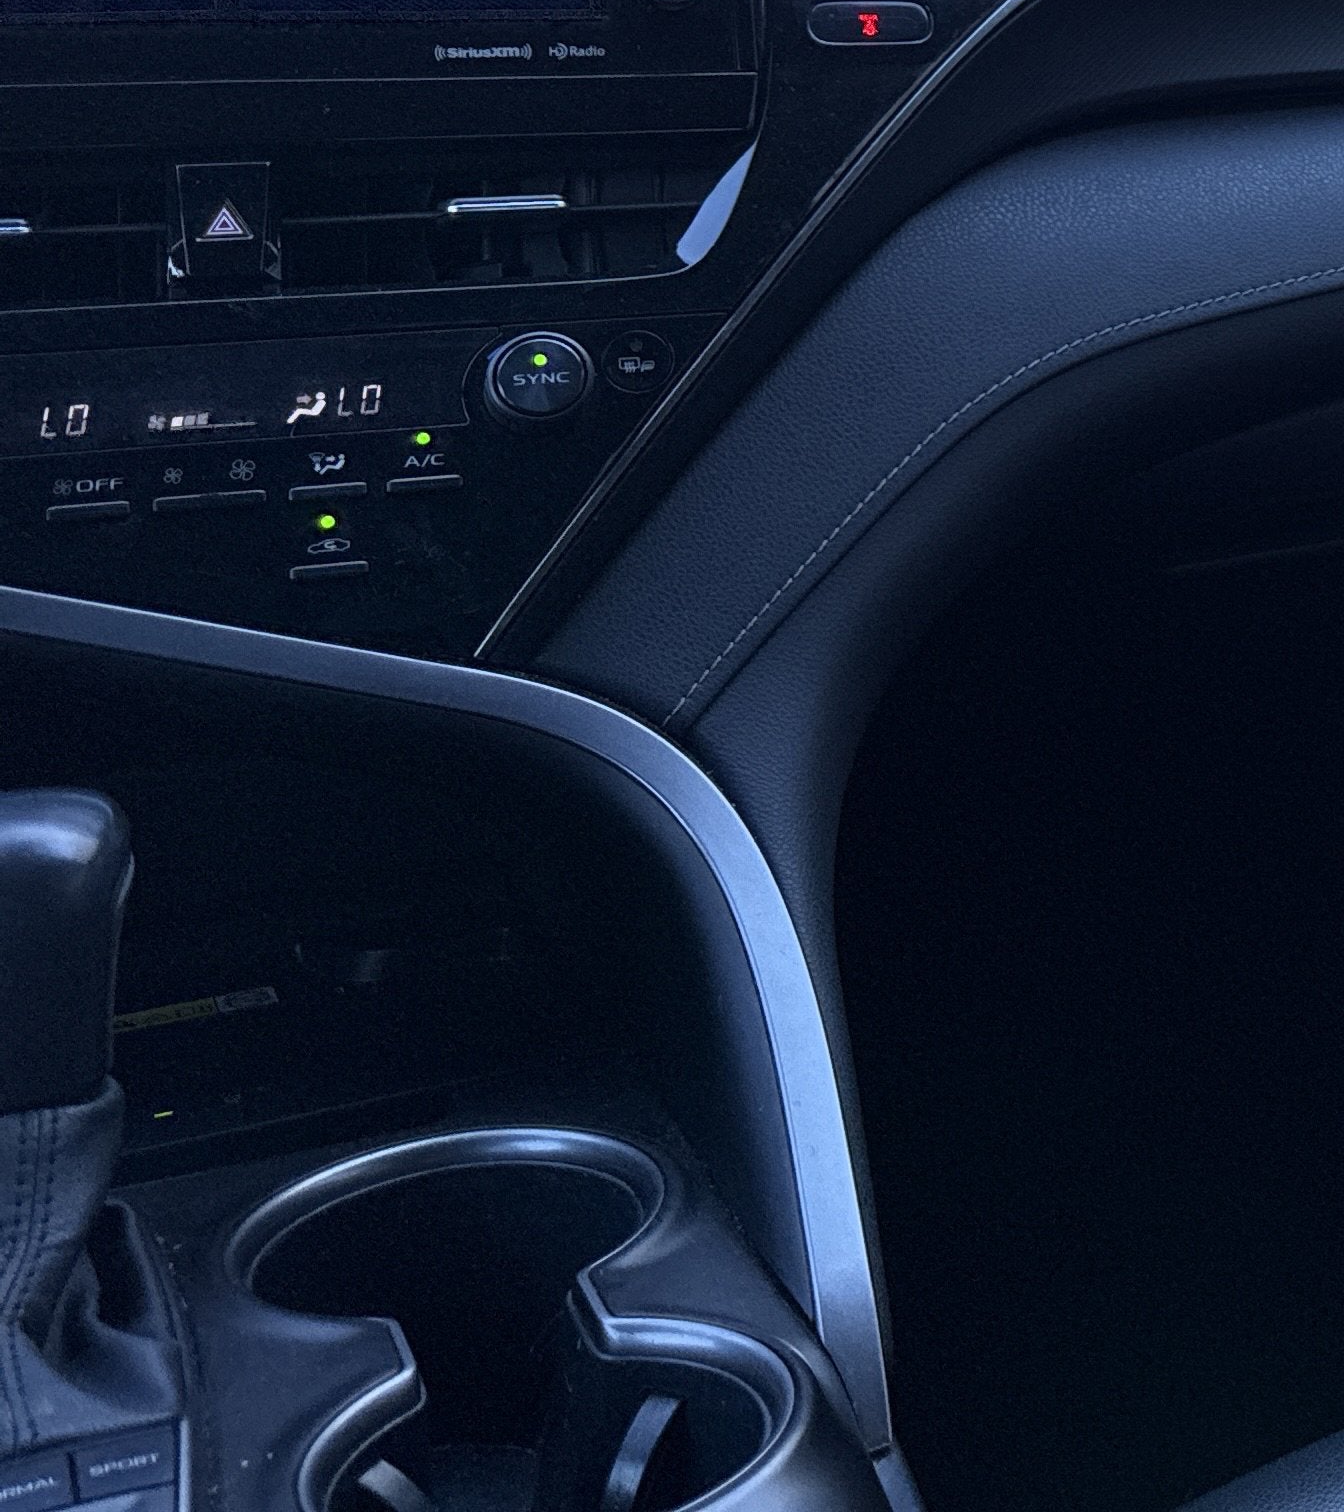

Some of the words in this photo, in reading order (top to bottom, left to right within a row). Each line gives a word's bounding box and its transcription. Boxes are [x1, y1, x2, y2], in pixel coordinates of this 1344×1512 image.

[569, 45, 605, 57] Radio
[512, 371, 570, 387] SYNC
[337, 384, 382, 417] LO
[40, 403, 90, 438] LO
[404, 453, 446, 468] A/C
[76, 476, 124, 493] OFF
